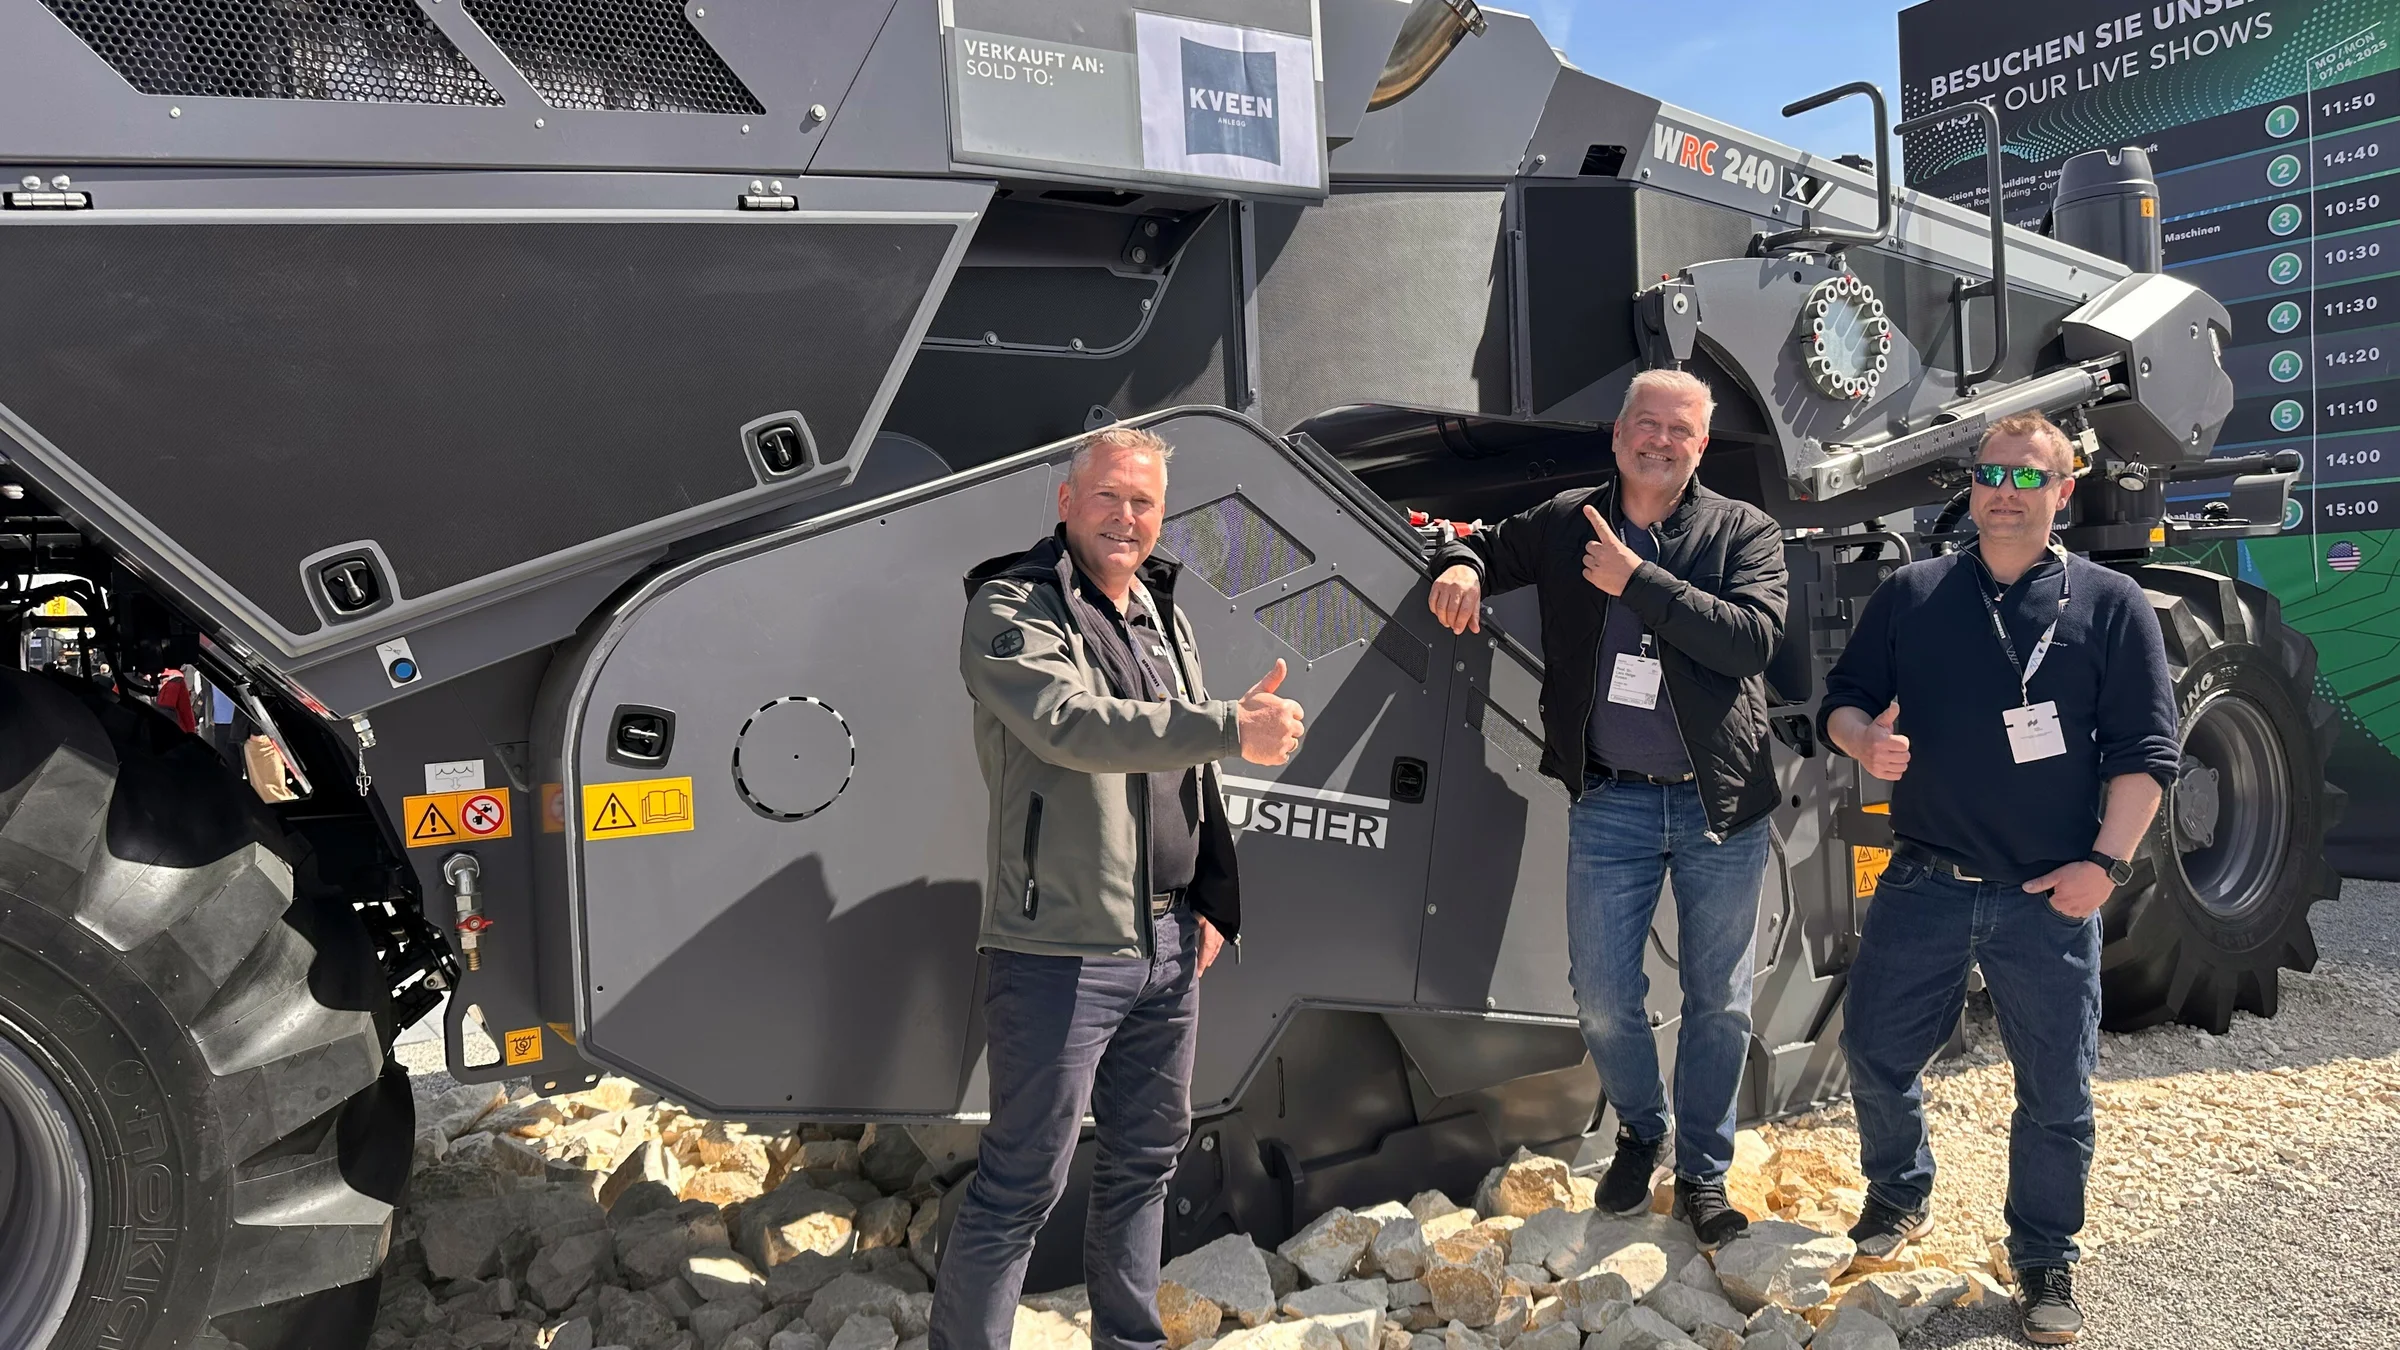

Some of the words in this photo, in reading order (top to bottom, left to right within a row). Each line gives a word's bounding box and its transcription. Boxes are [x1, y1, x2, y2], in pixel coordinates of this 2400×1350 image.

[964, 39, 1066, 69] VERKAUFT
[1071, 55, 1104, 74] AN:
[1930, 31, 2086, 100] BESUCHEN
[2095, 12, 2143, 49] SIE
[2314, 53, 2336, 70] MO
[2344, 32, 2376, 54] MON
[2318, 39, 2388, 80] 07.04.2025
[2004, 74, 2067, 111] OUR
[2077, 55, 2140, 91] LIVE
[2149, 12, 2273, 70] SHOWS
[966, 59, 1017, 81] SOLD
[1022, 67, 1054, 86] TO:
[1189, 87, 1273, 119] KVEEN
[2321, 92, 2376, 118] 11:50
[1217, 117, 1246, 128] ANLEGG
[2275, 113, 2286, 129] 1
[1653, 124, 1719, 175] WRC
[1721, 148, 1775, 194] 240
[2323, 143, 2379, 167] 14:40
[2277, 163, 2290, 180] 2
[2324, 194, 2380, 217] 10:50
[2278, 211, 2291, 228] 3
[2164, 225, 2221, 243] Maschinen
[2324, 243, 2380, 265] 10:30
[2278, 261, 2291, 277] 2
[2324, 296, 2378, 316] 11:30
[2276, 309, 2291, 325] 4
[2278, 358, 2292, 374] 4
[2325, 347, 2380, 367] 14:20
[2280, 407, 2293, 424] 5
[2326, 398, 2378, 417] 11:10
[2326, 449, 2381, 467] 14:00
[2325, 500, 2379, 517] 15:00
[1223, 794, 1379, 848] USHER
